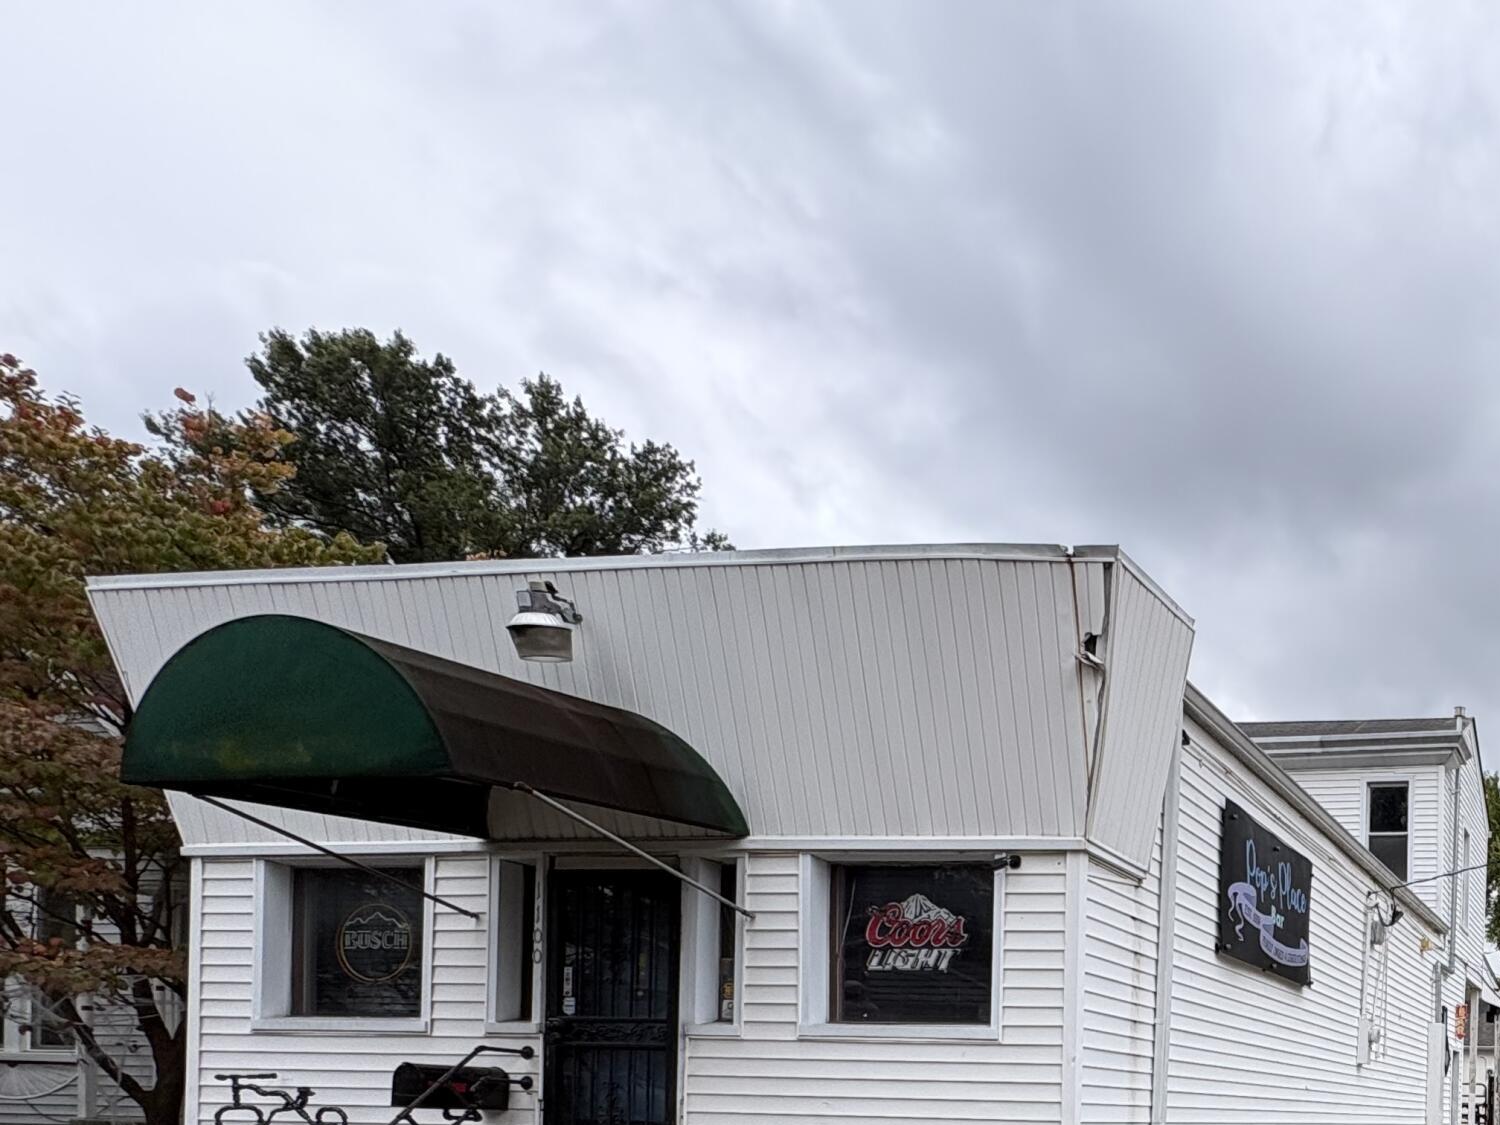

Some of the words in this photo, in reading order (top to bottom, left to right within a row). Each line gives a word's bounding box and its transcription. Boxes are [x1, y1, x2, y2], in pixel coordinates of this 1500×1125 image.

[1246, 839, 1277, 903] Pop's
[1278, 861, 1307, 913] Place
[866, 902, 968, 947] Coors
[1271, 904, 1285, 929] Bar
[344, 930, 408, 949] BUSCH
[866, 948, 961, 971] LIGHT
